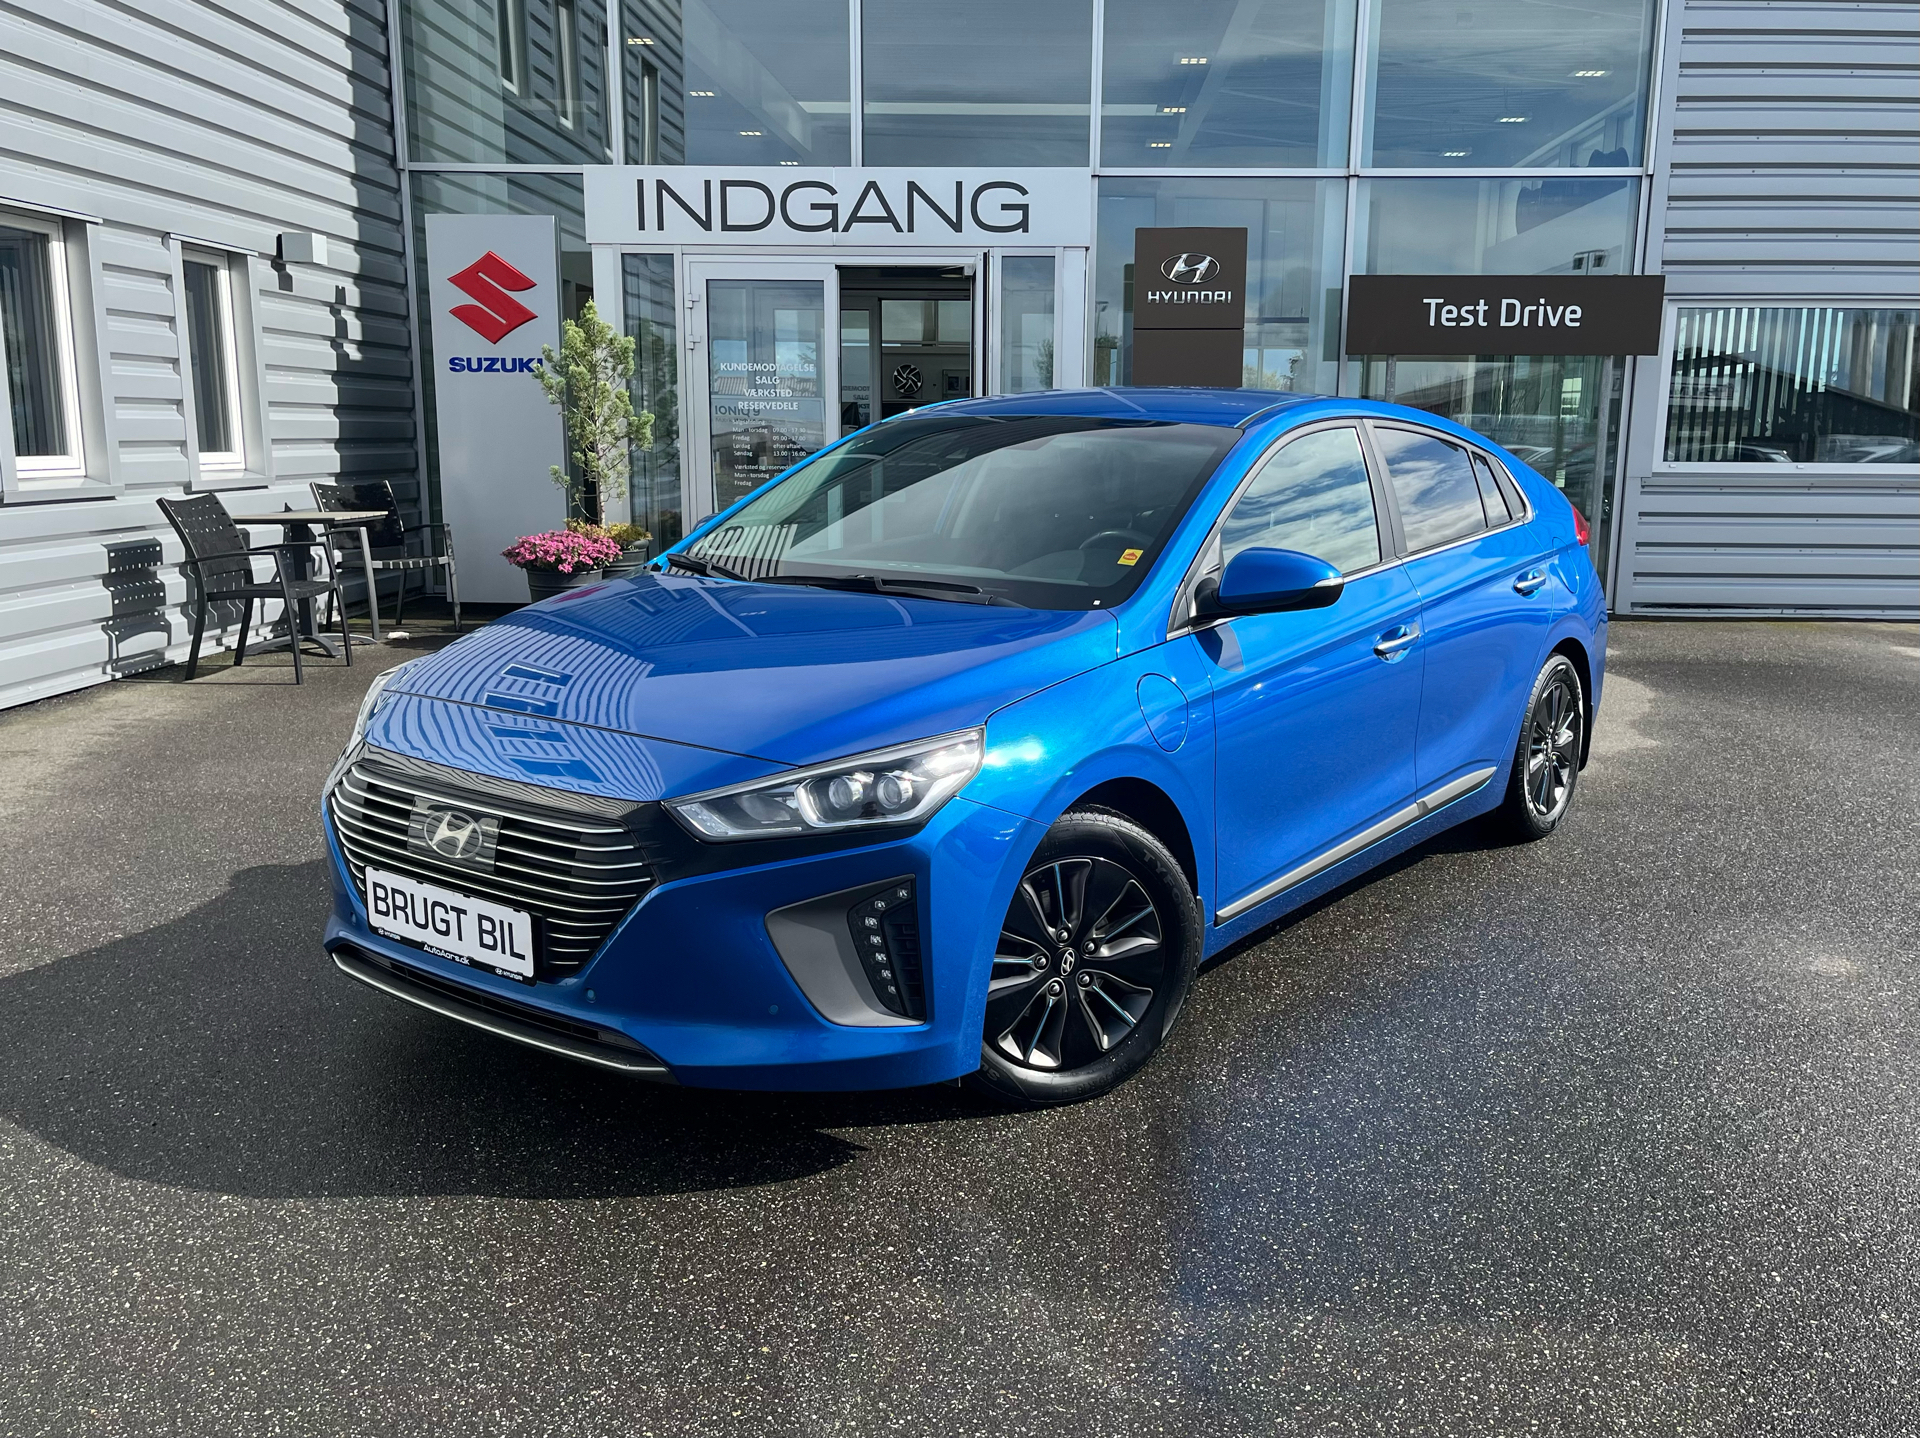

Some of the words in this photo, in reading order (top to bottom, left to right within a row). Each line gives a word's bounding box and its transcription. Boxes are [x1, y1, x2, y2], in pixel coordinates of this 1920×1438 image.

[636, 178, 1029, 234] INDGANG
[1147, 289, 1232, 304] HYUNDAI
[1423, 297, 1487, 327] Test
[1499, 297, 1583, 328] Drive
[720, 362, 815, 372] KUNDEMODTAGELSE
[755, 376, 780, 385] SALG
[743, 389, 793, 397] VÆRKSTED
[738, 402, 799, 411] RESERVEDELE
[372, 881, 468, 942] BRUGT
[477, 913, 526, 961] BIL
[423, 943, 471, 966] AutoAars.dk
